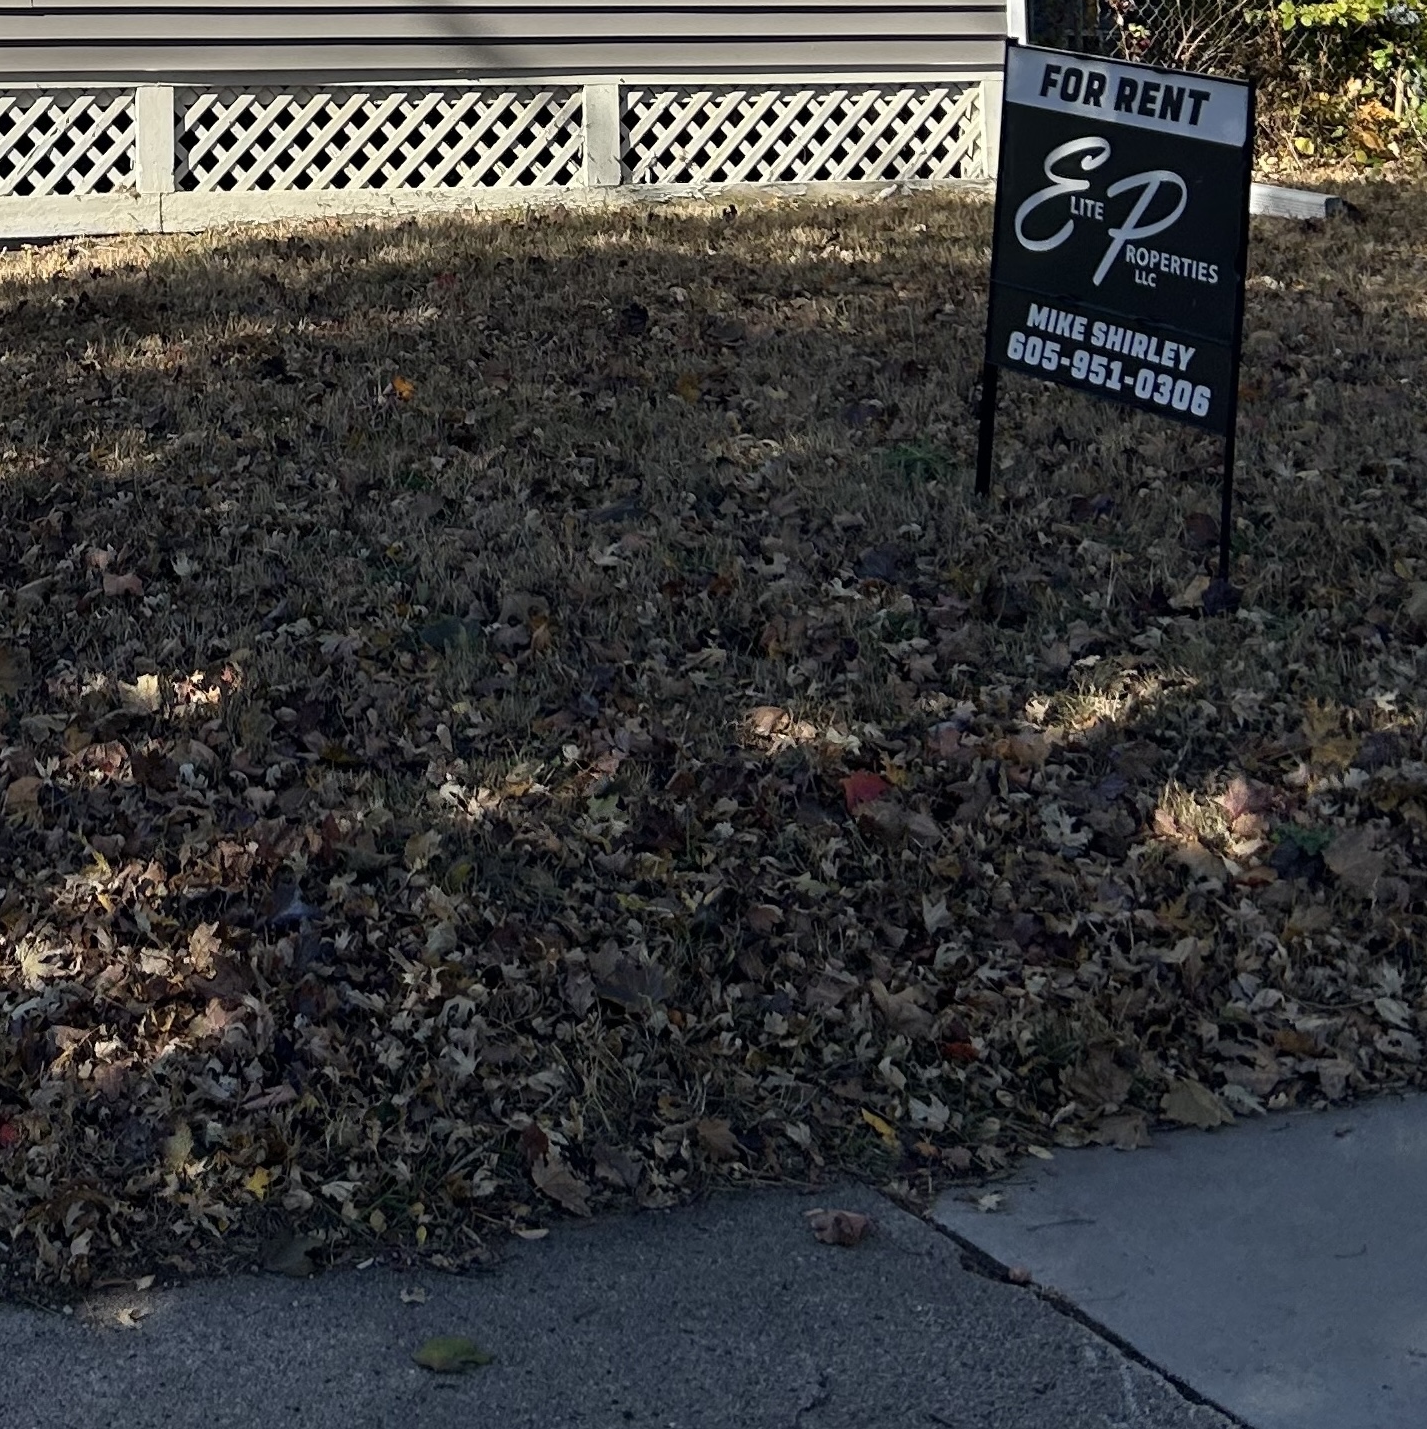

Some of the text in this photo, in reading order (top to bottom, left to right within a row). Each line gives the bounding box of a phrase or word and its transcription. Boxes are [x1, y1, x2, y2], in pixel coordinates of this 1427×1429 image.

[1039, 64, 1211, 126] FOR RENT
[1134, 269, 1157, 288] LLC
[1026, 303, 1195, 371] MIKE SHIRLEY
[1007, 330, 1212, 417] 605-951-0306
